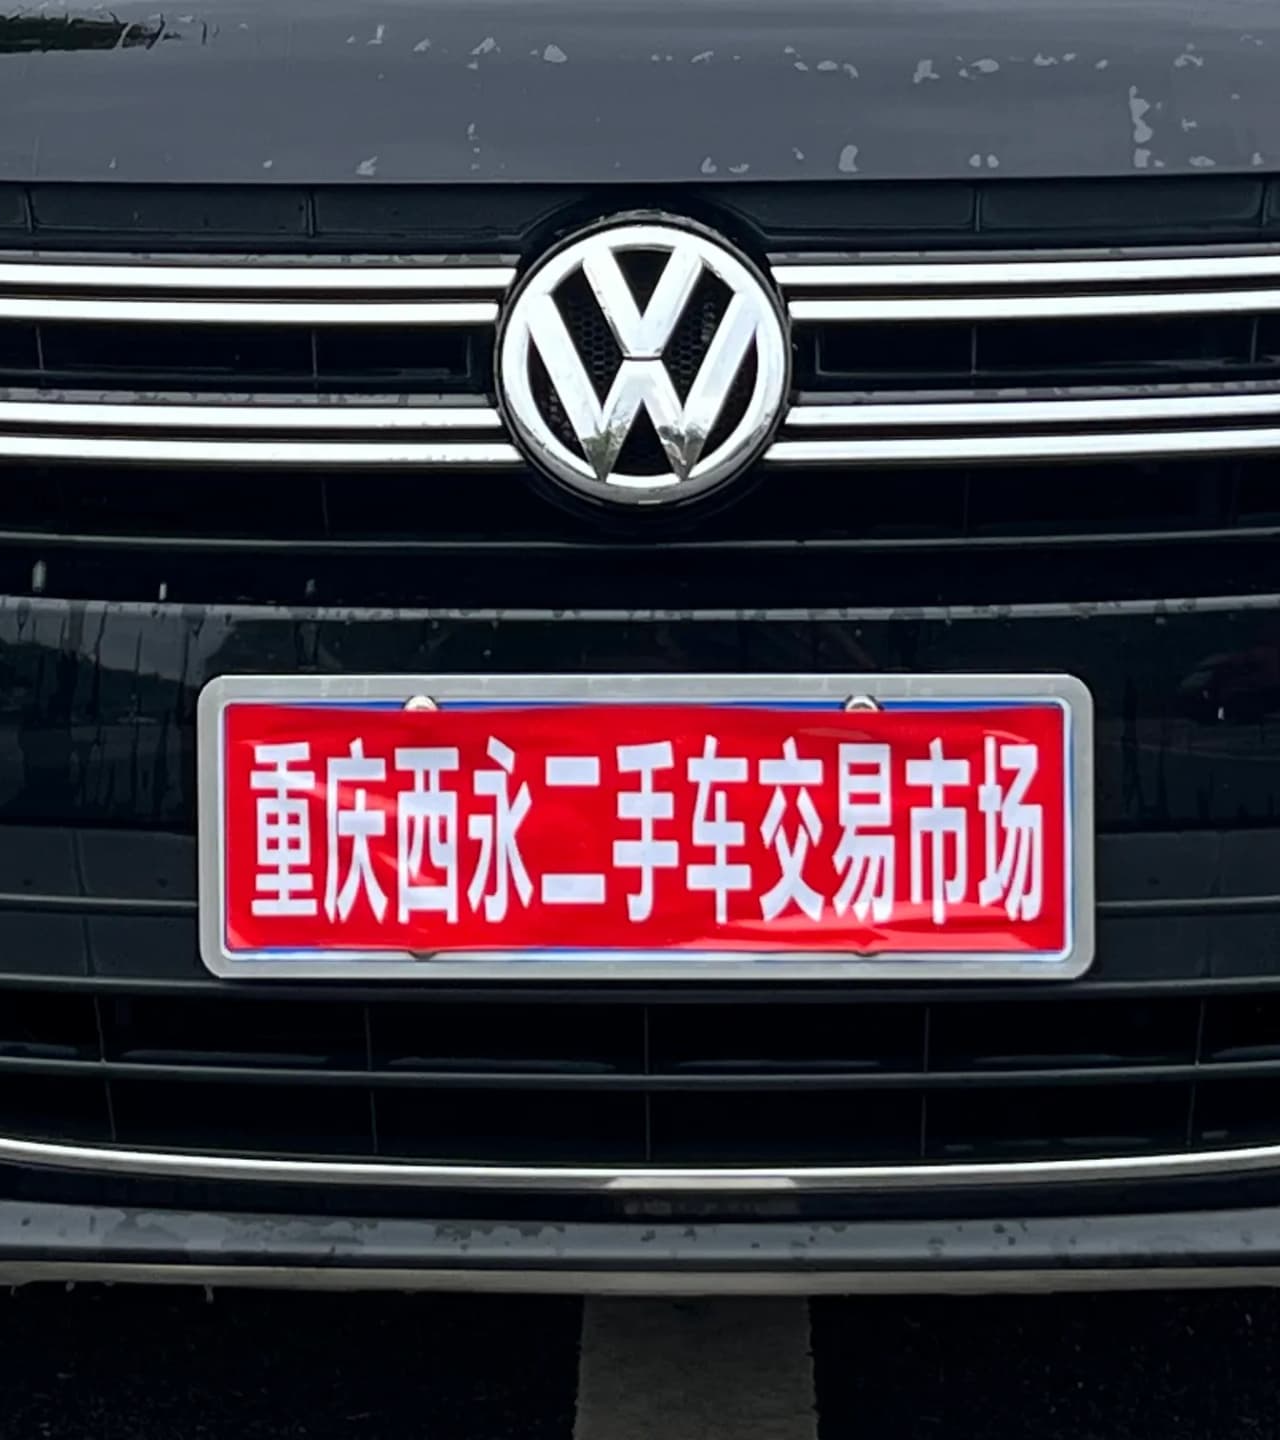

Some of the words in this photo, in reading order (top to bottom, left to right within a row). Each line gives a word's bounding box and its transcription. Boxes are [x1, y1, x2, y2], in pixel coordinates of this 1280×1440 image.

[250, 735, 1043, 925] 重庆西永二手车交易市场
